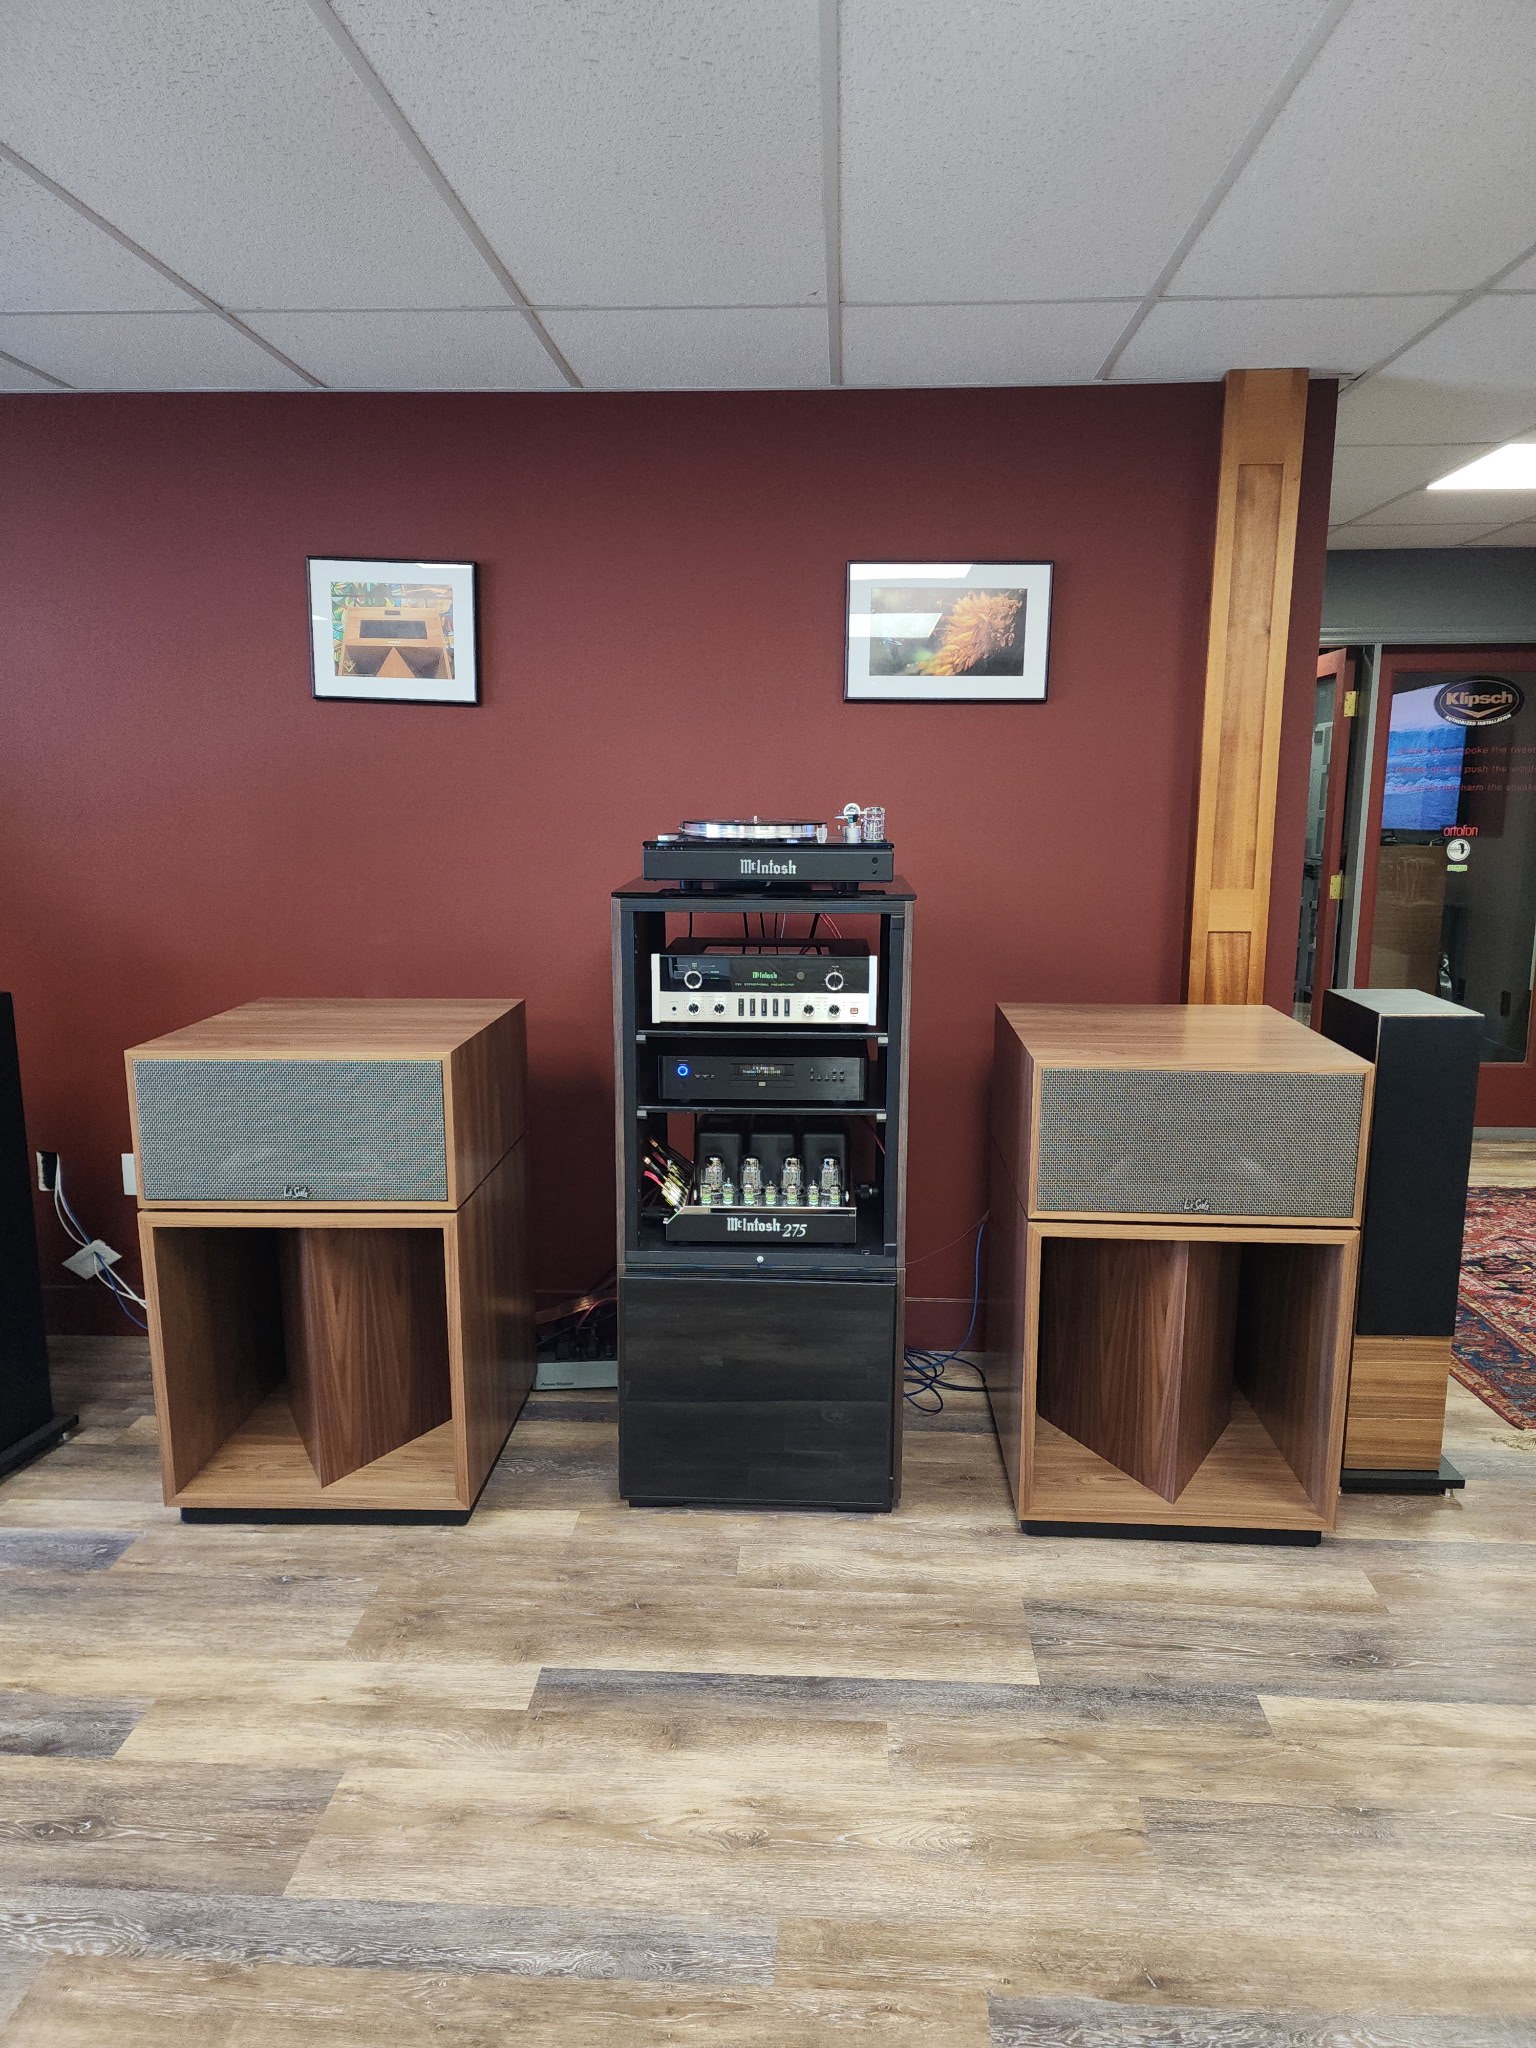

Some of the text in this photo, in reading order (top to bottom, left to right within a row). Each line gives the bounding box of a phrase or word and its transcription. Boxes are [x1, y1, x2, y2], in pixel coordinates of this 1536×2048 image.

[1445, 690, 1513, 707] Klipsch
[1444, 713, 1512, 726] AUTHORIZED INSTALLATION
[1464, 746, 1489, 755] poke
[1491, 746, 1507, 754] the
[1463, 765, 1488, 774] push
[1460, 784, 1484, 792] harm
[1443, 824, 1479, 837] ortofon
[740, 858, 797, 875] McIntosh
[727, 1217, 808, 1238] McIntosh 275
